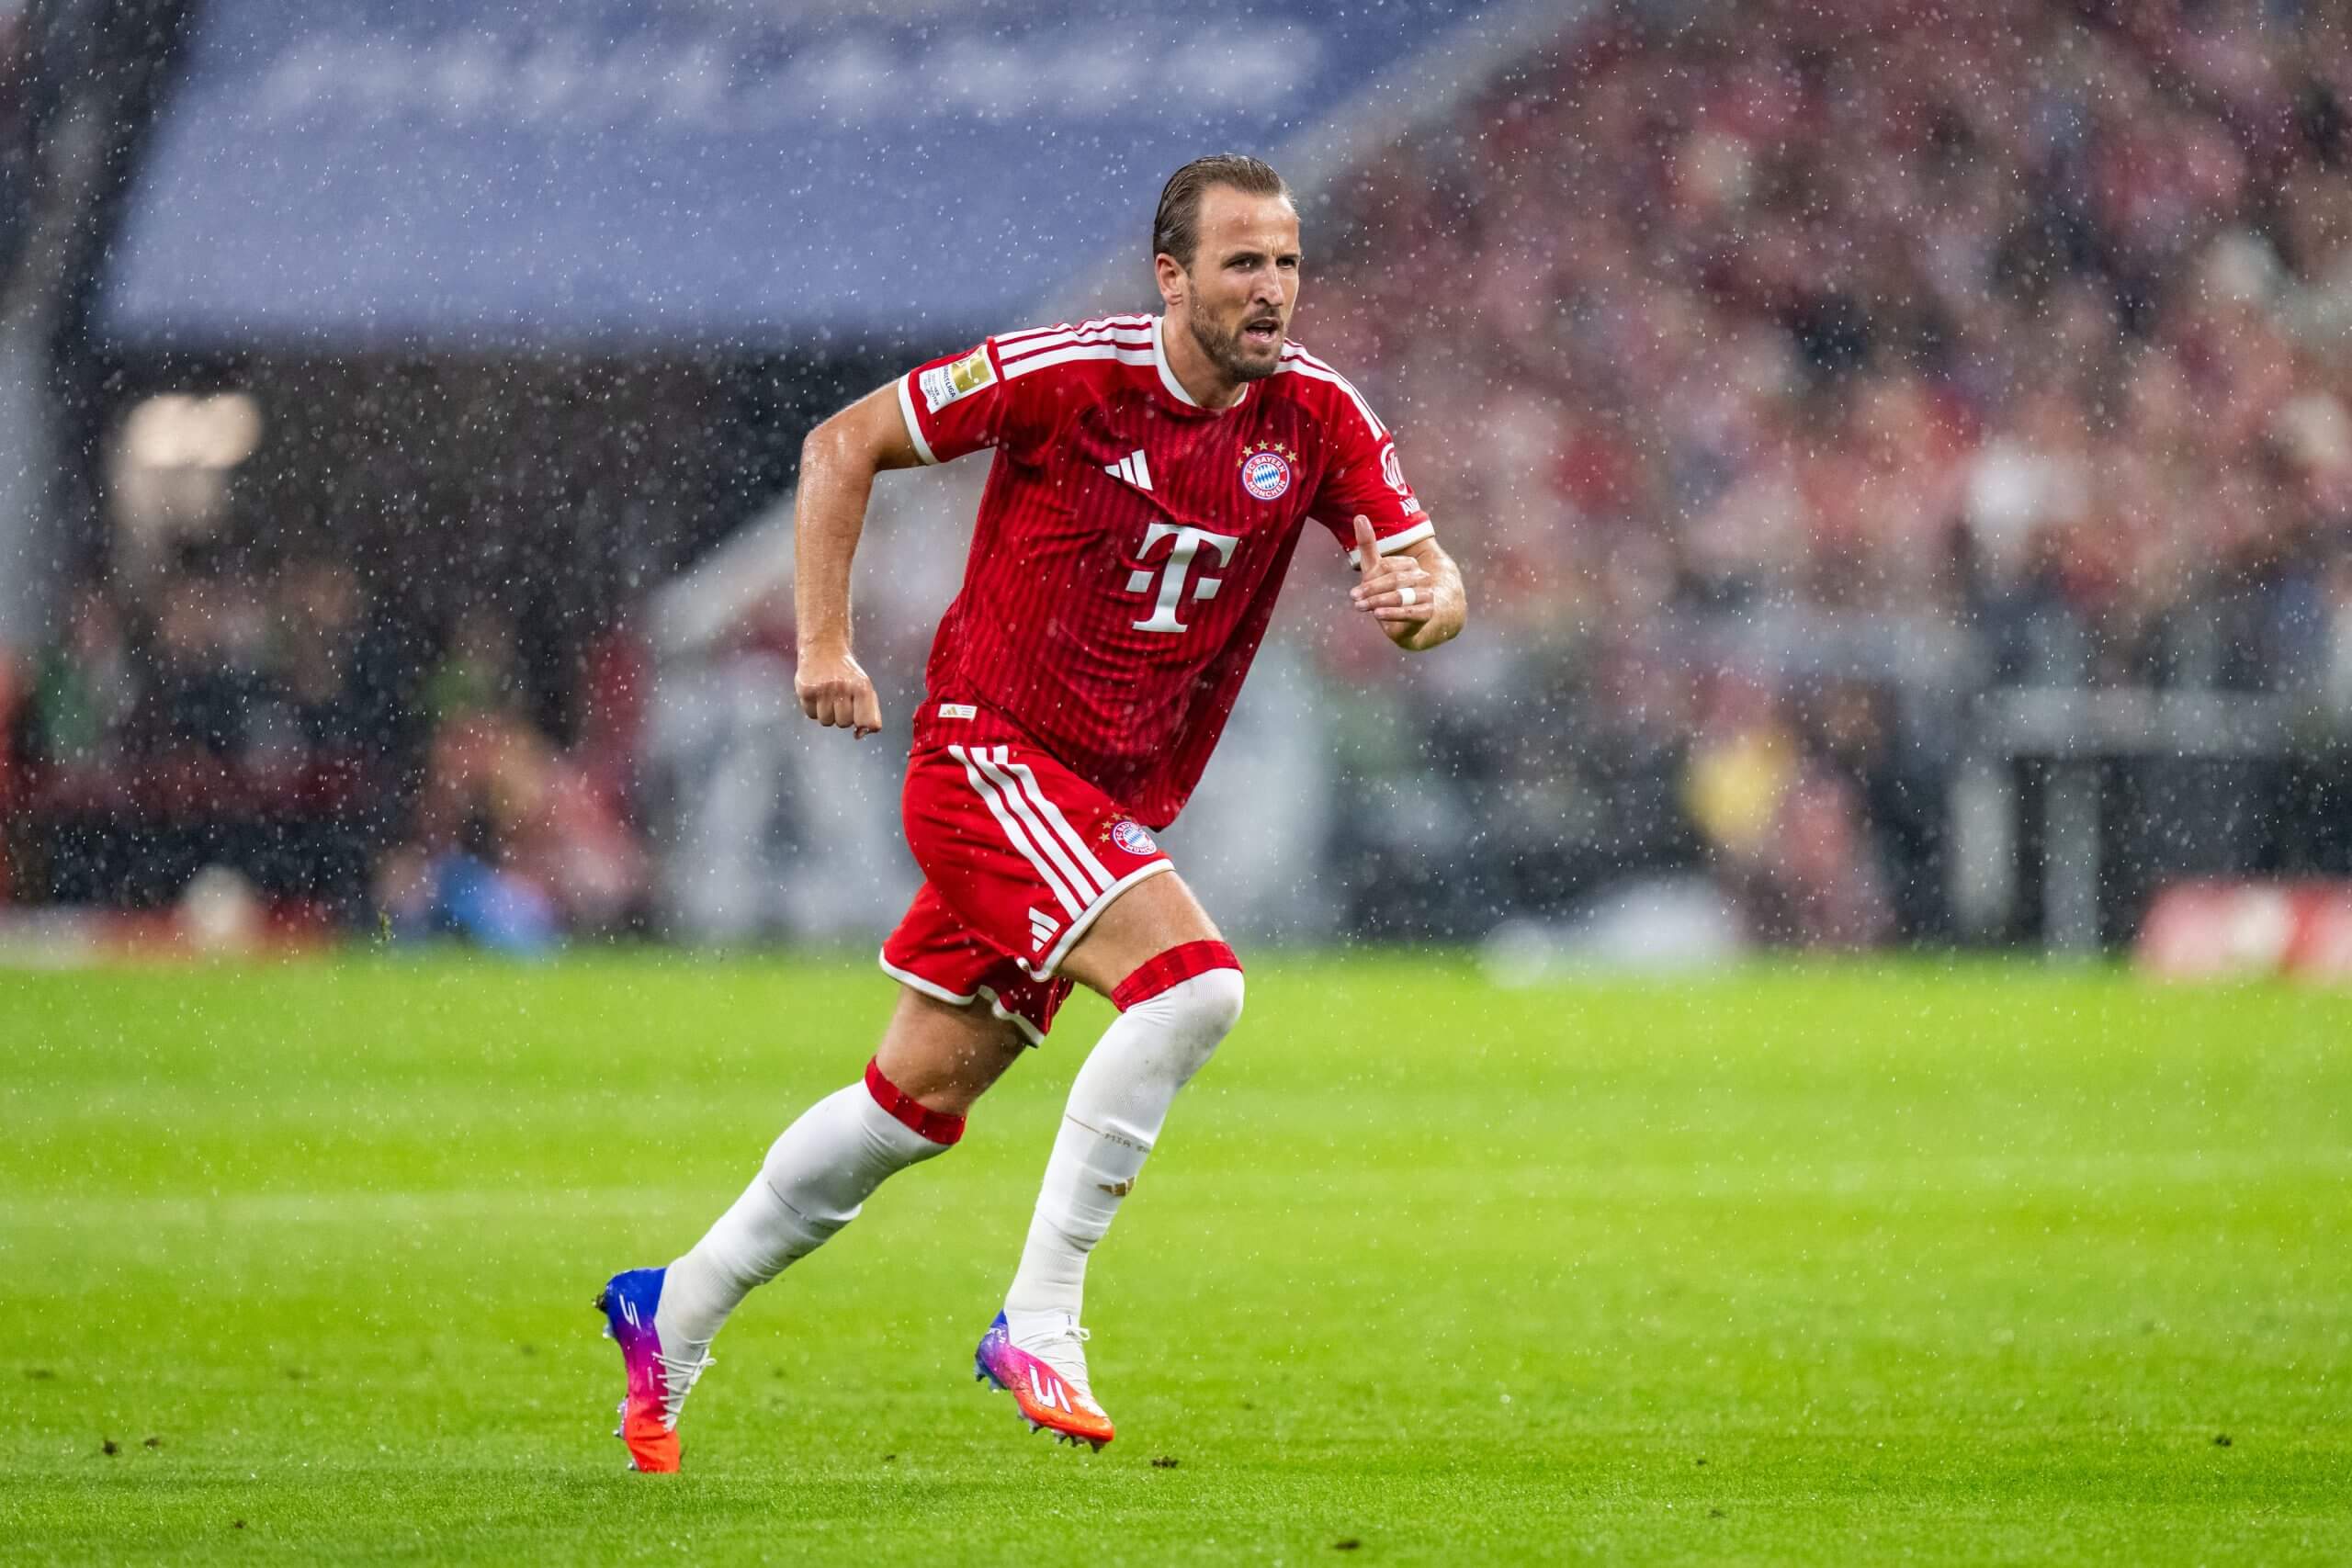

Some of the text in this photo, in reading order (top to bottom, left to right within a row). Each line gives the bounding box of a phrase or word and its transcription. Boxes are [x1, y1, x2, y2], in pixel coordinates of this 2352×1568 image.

[1247, 457, 1285, 474] FC BAYERN
[1125, 523, 1239, 632] T
